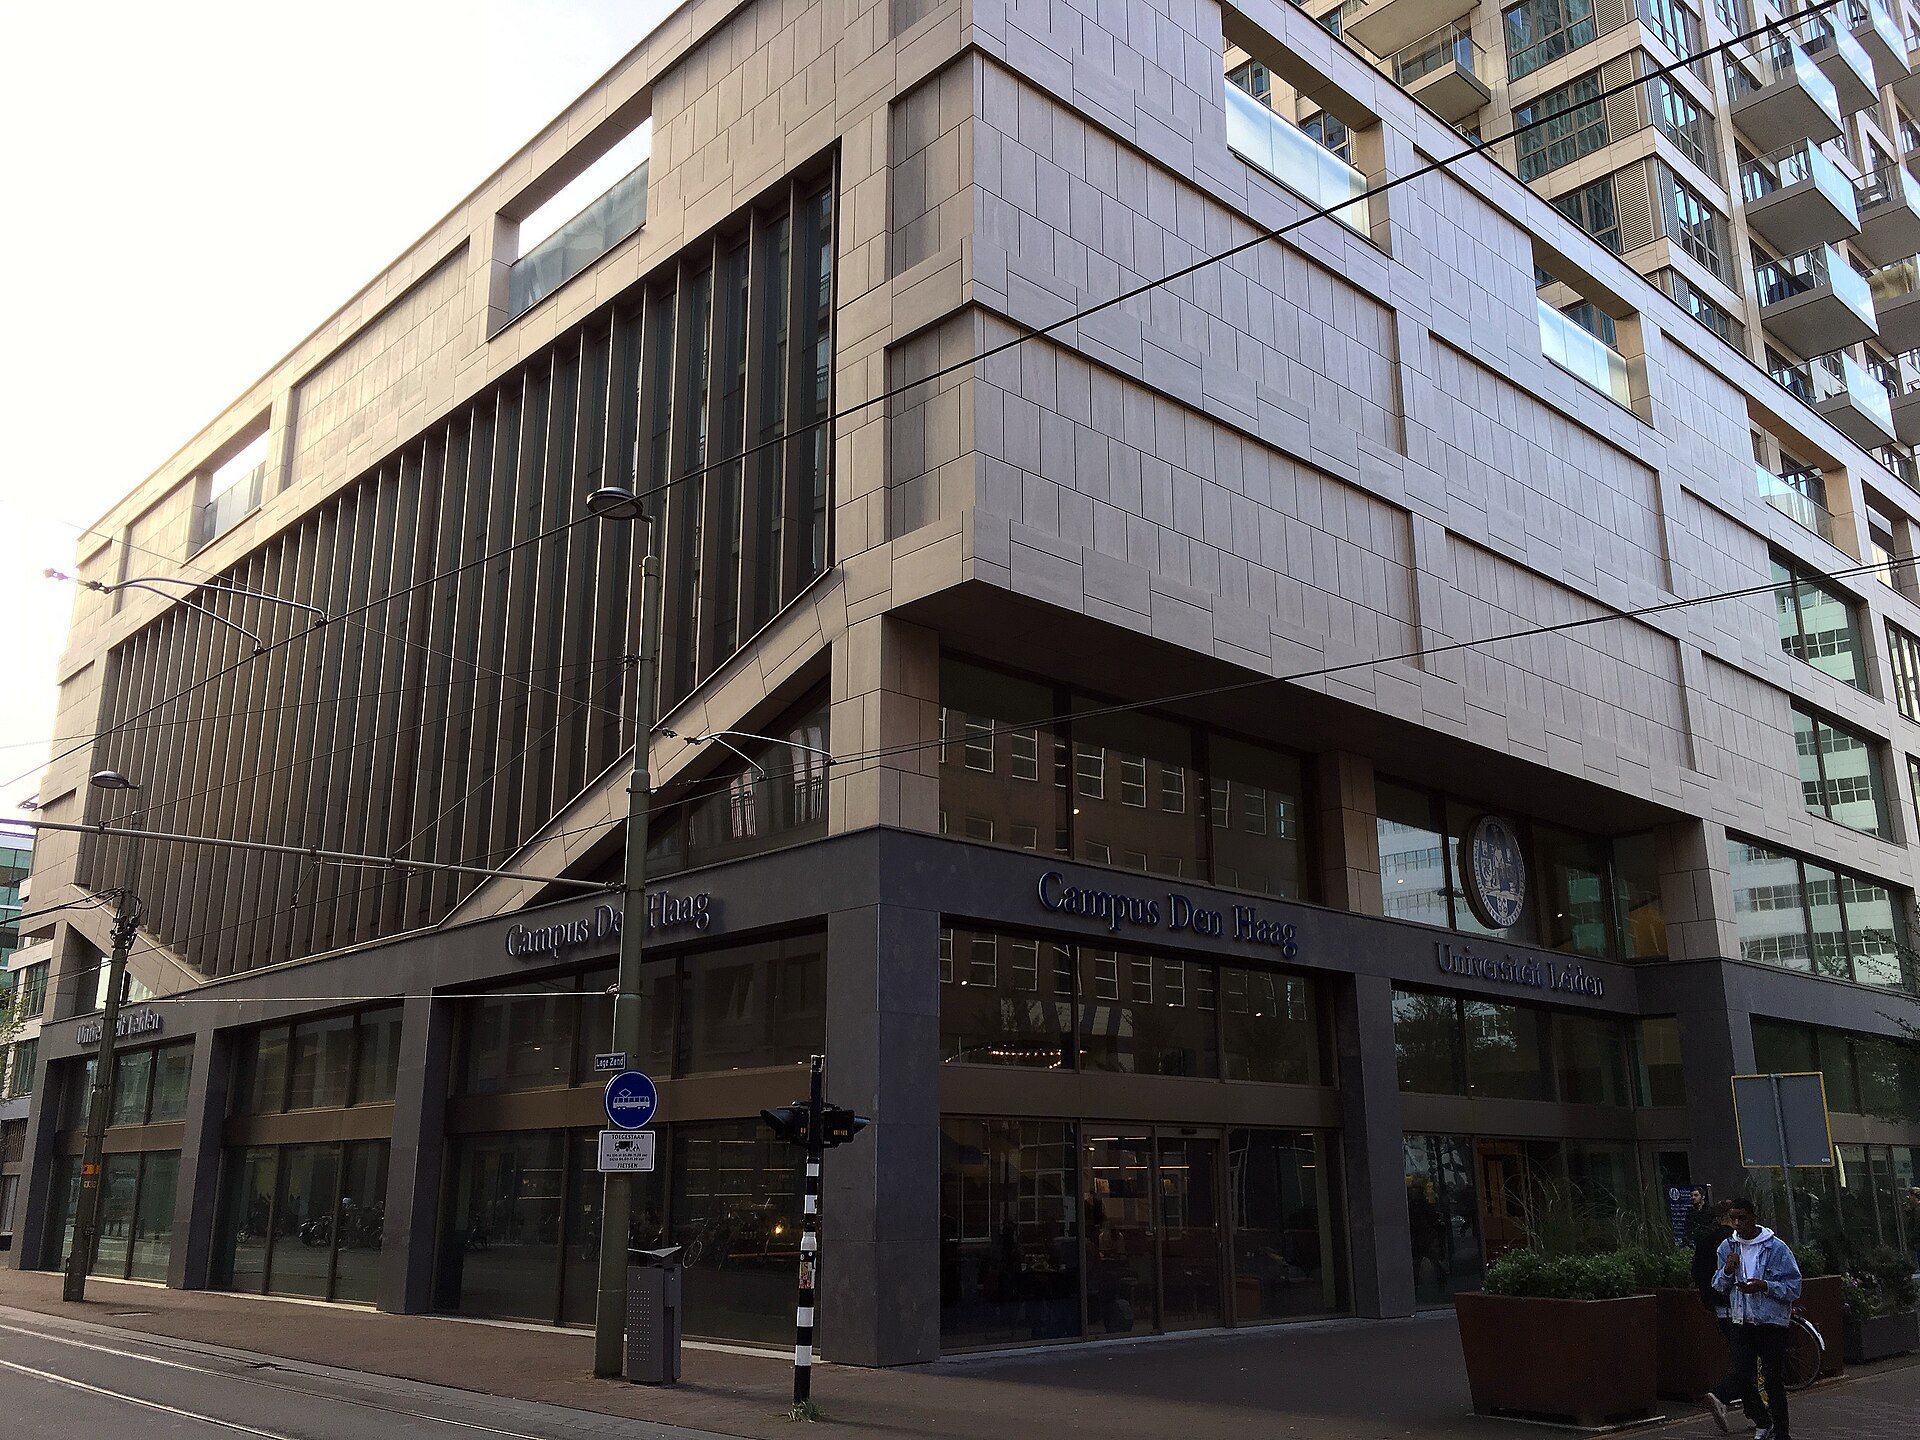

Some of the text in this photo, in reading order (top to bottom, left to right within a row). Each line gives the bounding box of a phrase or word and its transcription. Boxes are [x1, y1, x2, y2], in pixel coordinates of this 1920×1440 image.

[505, 890, 710, 958] Campus De Haag
[1038, 871, 1298, 958] Campus Den Haag
[1435, 940, 1605, 997] Universiteit Leiden
[596, 1057, 624, 1069] Lage Zand
